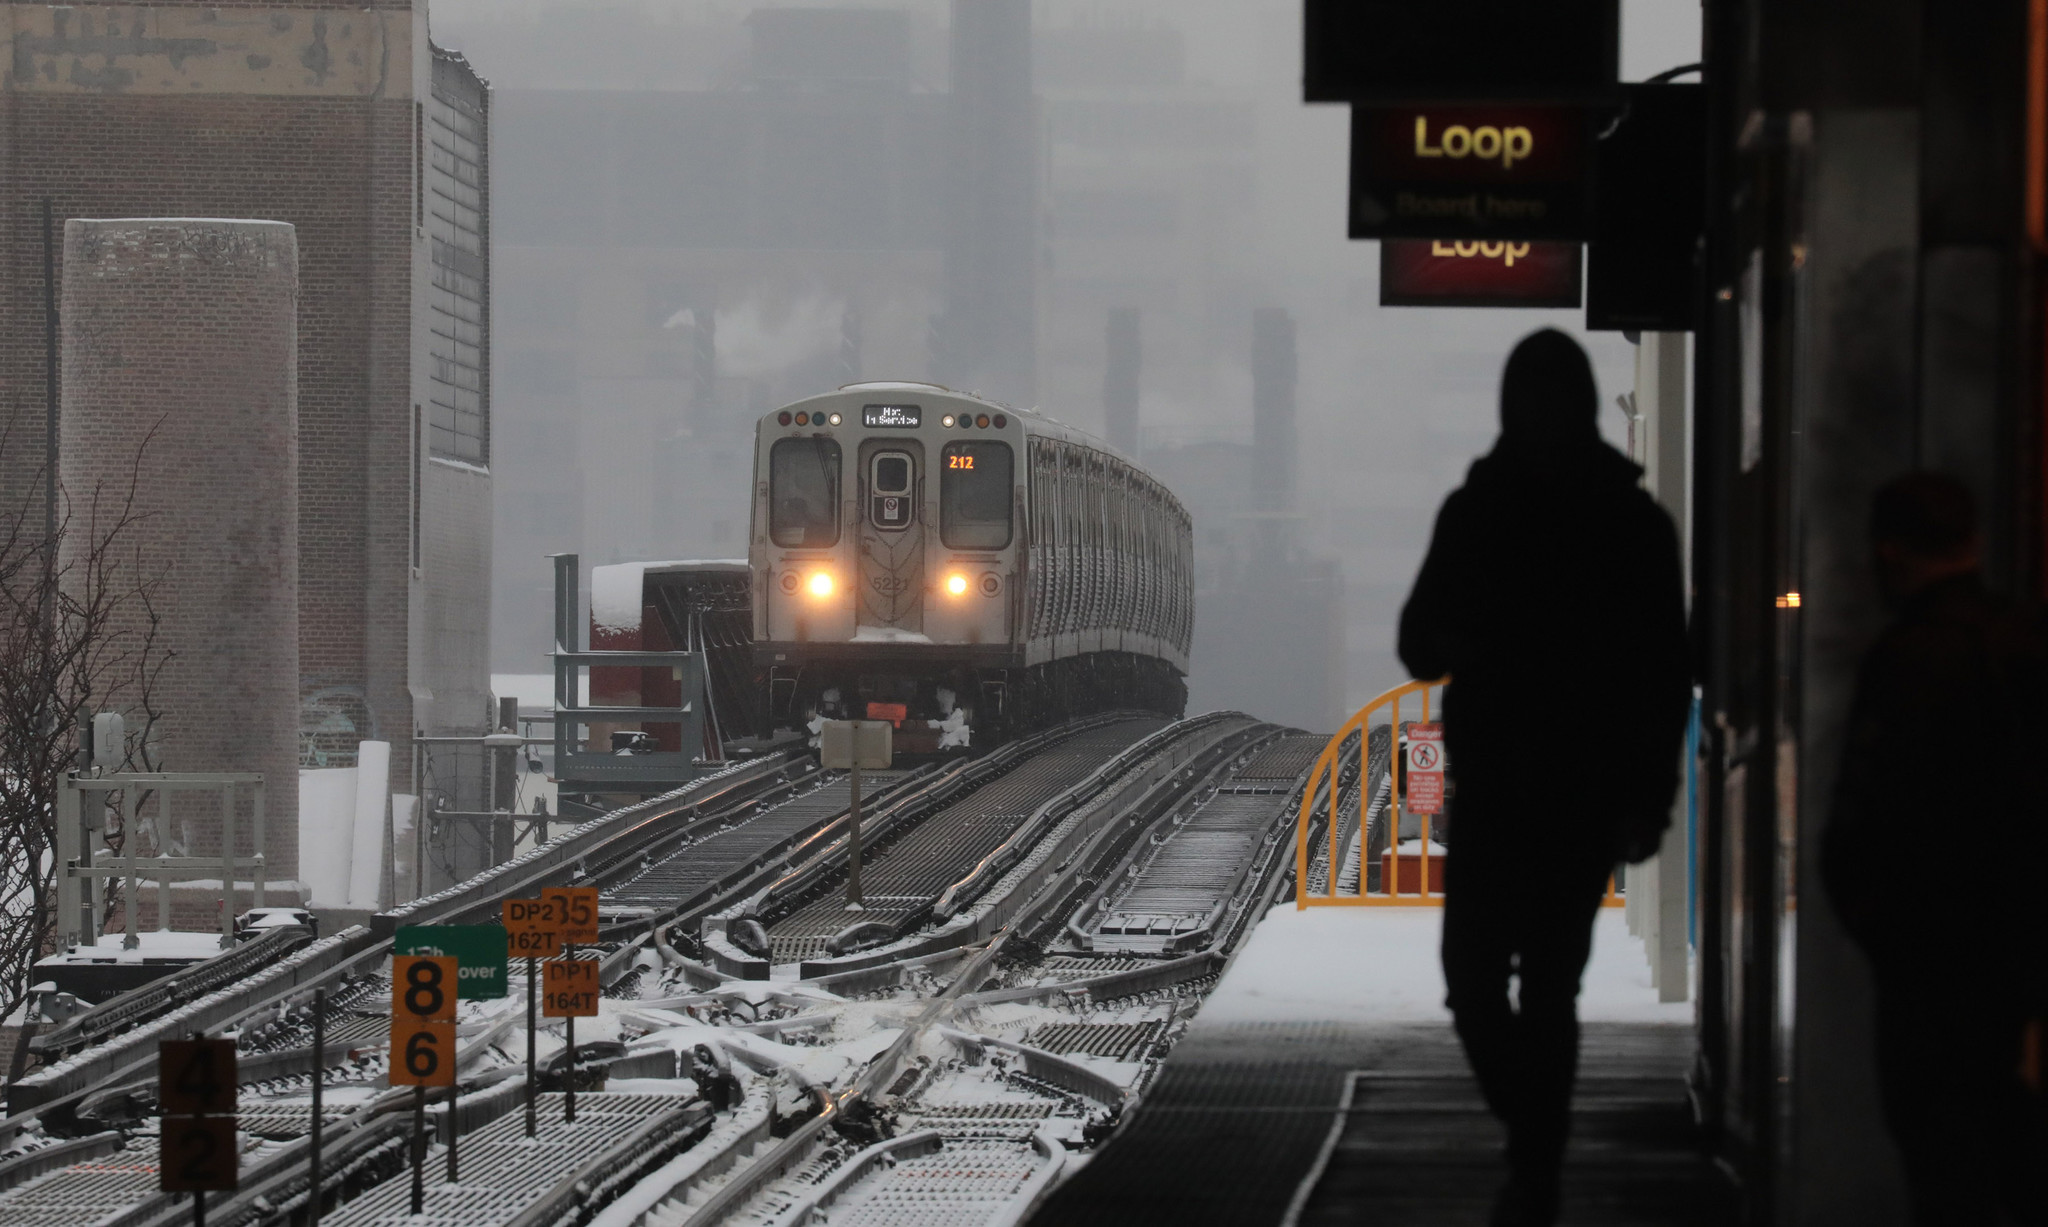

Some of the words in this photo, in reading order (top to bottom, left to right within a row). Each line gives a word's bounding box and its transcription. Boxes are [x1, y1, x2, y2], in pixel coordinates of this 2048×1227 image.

[1415, 116, 1533, 169] Loop
[1396, 193, 1475, 216] Board
[1487, 193, 1546, 217] here
[949, 455, 974, 469] 212
[1411, 729, 1441, 739] Danger
[510, 904, 554, 920] DP2
[508, 932, 555, 950] 162T
[550, 963, 591, 980] DP1
[405, 961, 444, 1016] 8
[547, 993, 594, 1009] 164T
[405, 1031, 438, 1077] 6
[176, 1045, 221, 1106] 4
[179, 1128, 216, 1180] 2
